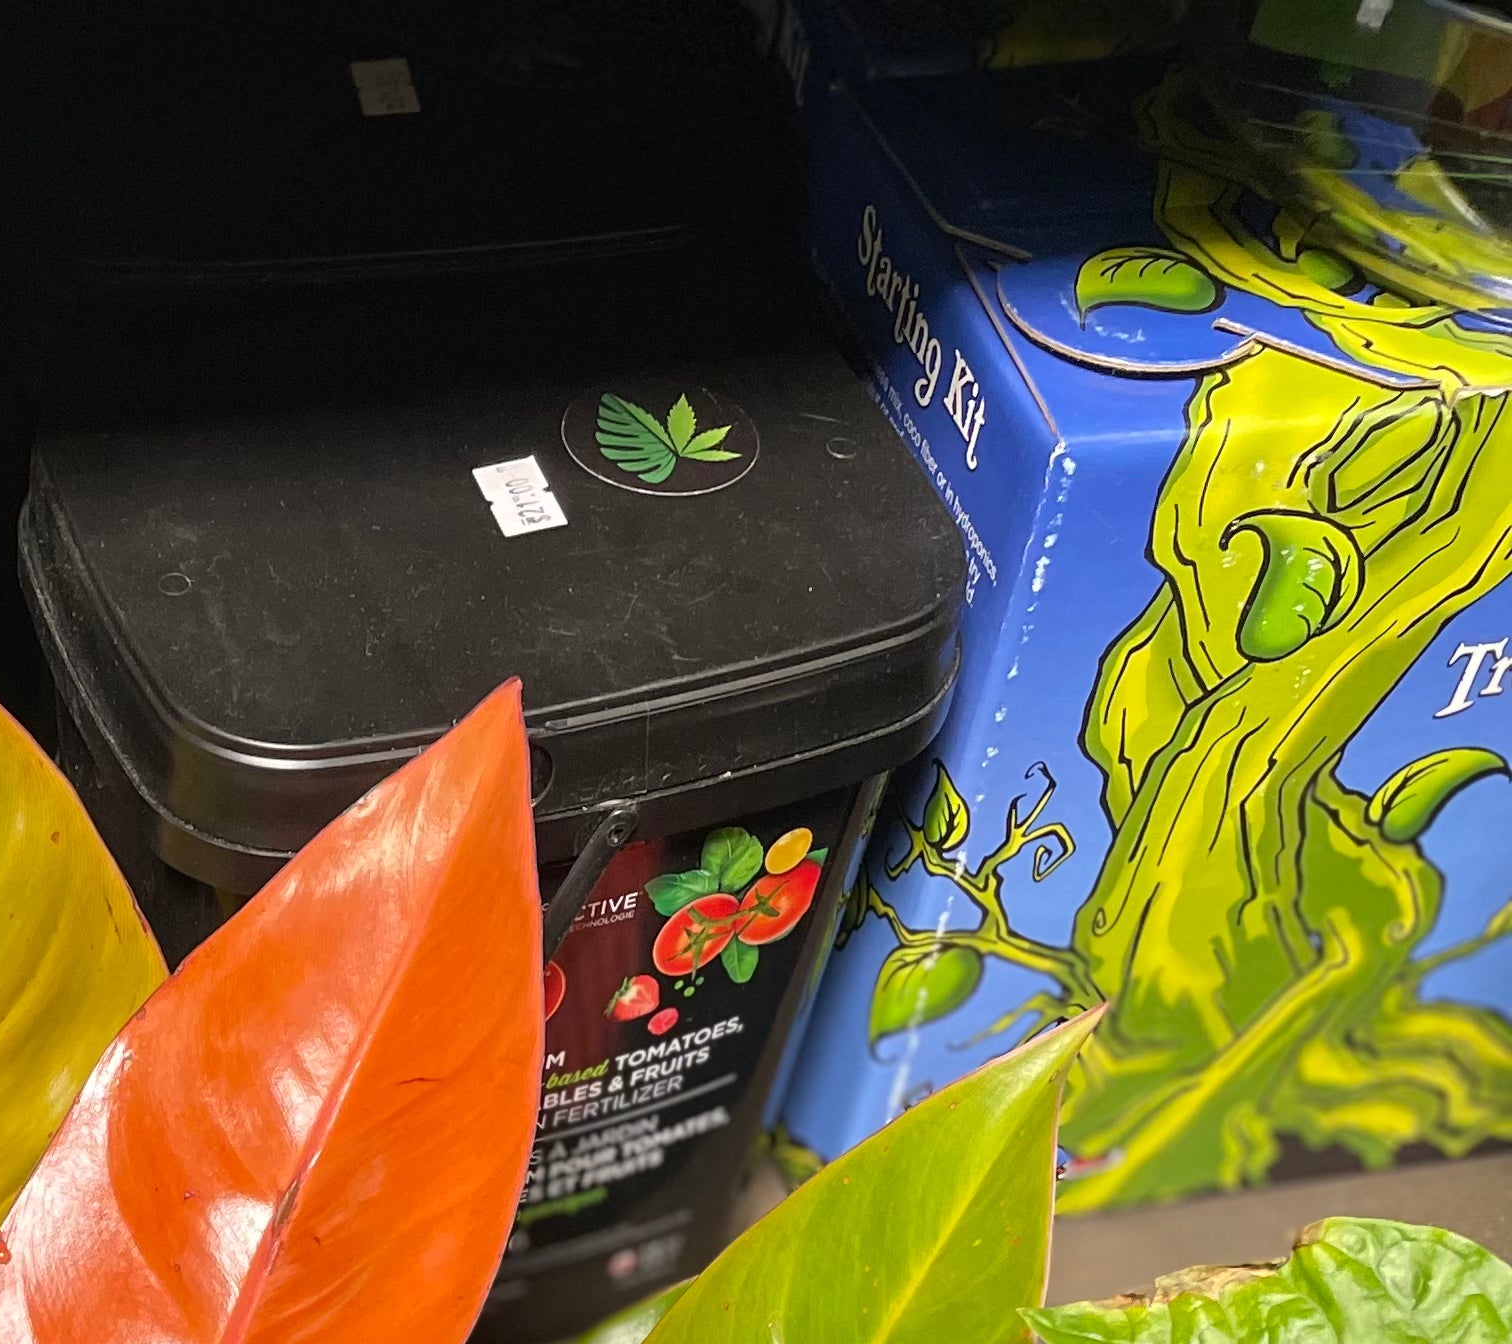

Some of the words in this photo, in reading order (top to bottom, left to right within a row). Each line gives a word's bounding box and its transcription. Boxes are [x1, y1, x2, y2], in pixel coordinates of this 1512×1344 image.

[857, 204, 943, 408] Starting
[943, 348, 986, 470] Kit
[903, 413, 921, 447] coco
[952, 496, 997, 587] hydroponics,
[607, 1075, 624, 1093] &
[629, 1046, 711, 1088] FRUITS
[614, 1015, 745, 1072] TOMATOES,
[552, 1075, 684, 1127] FERTILIZER
